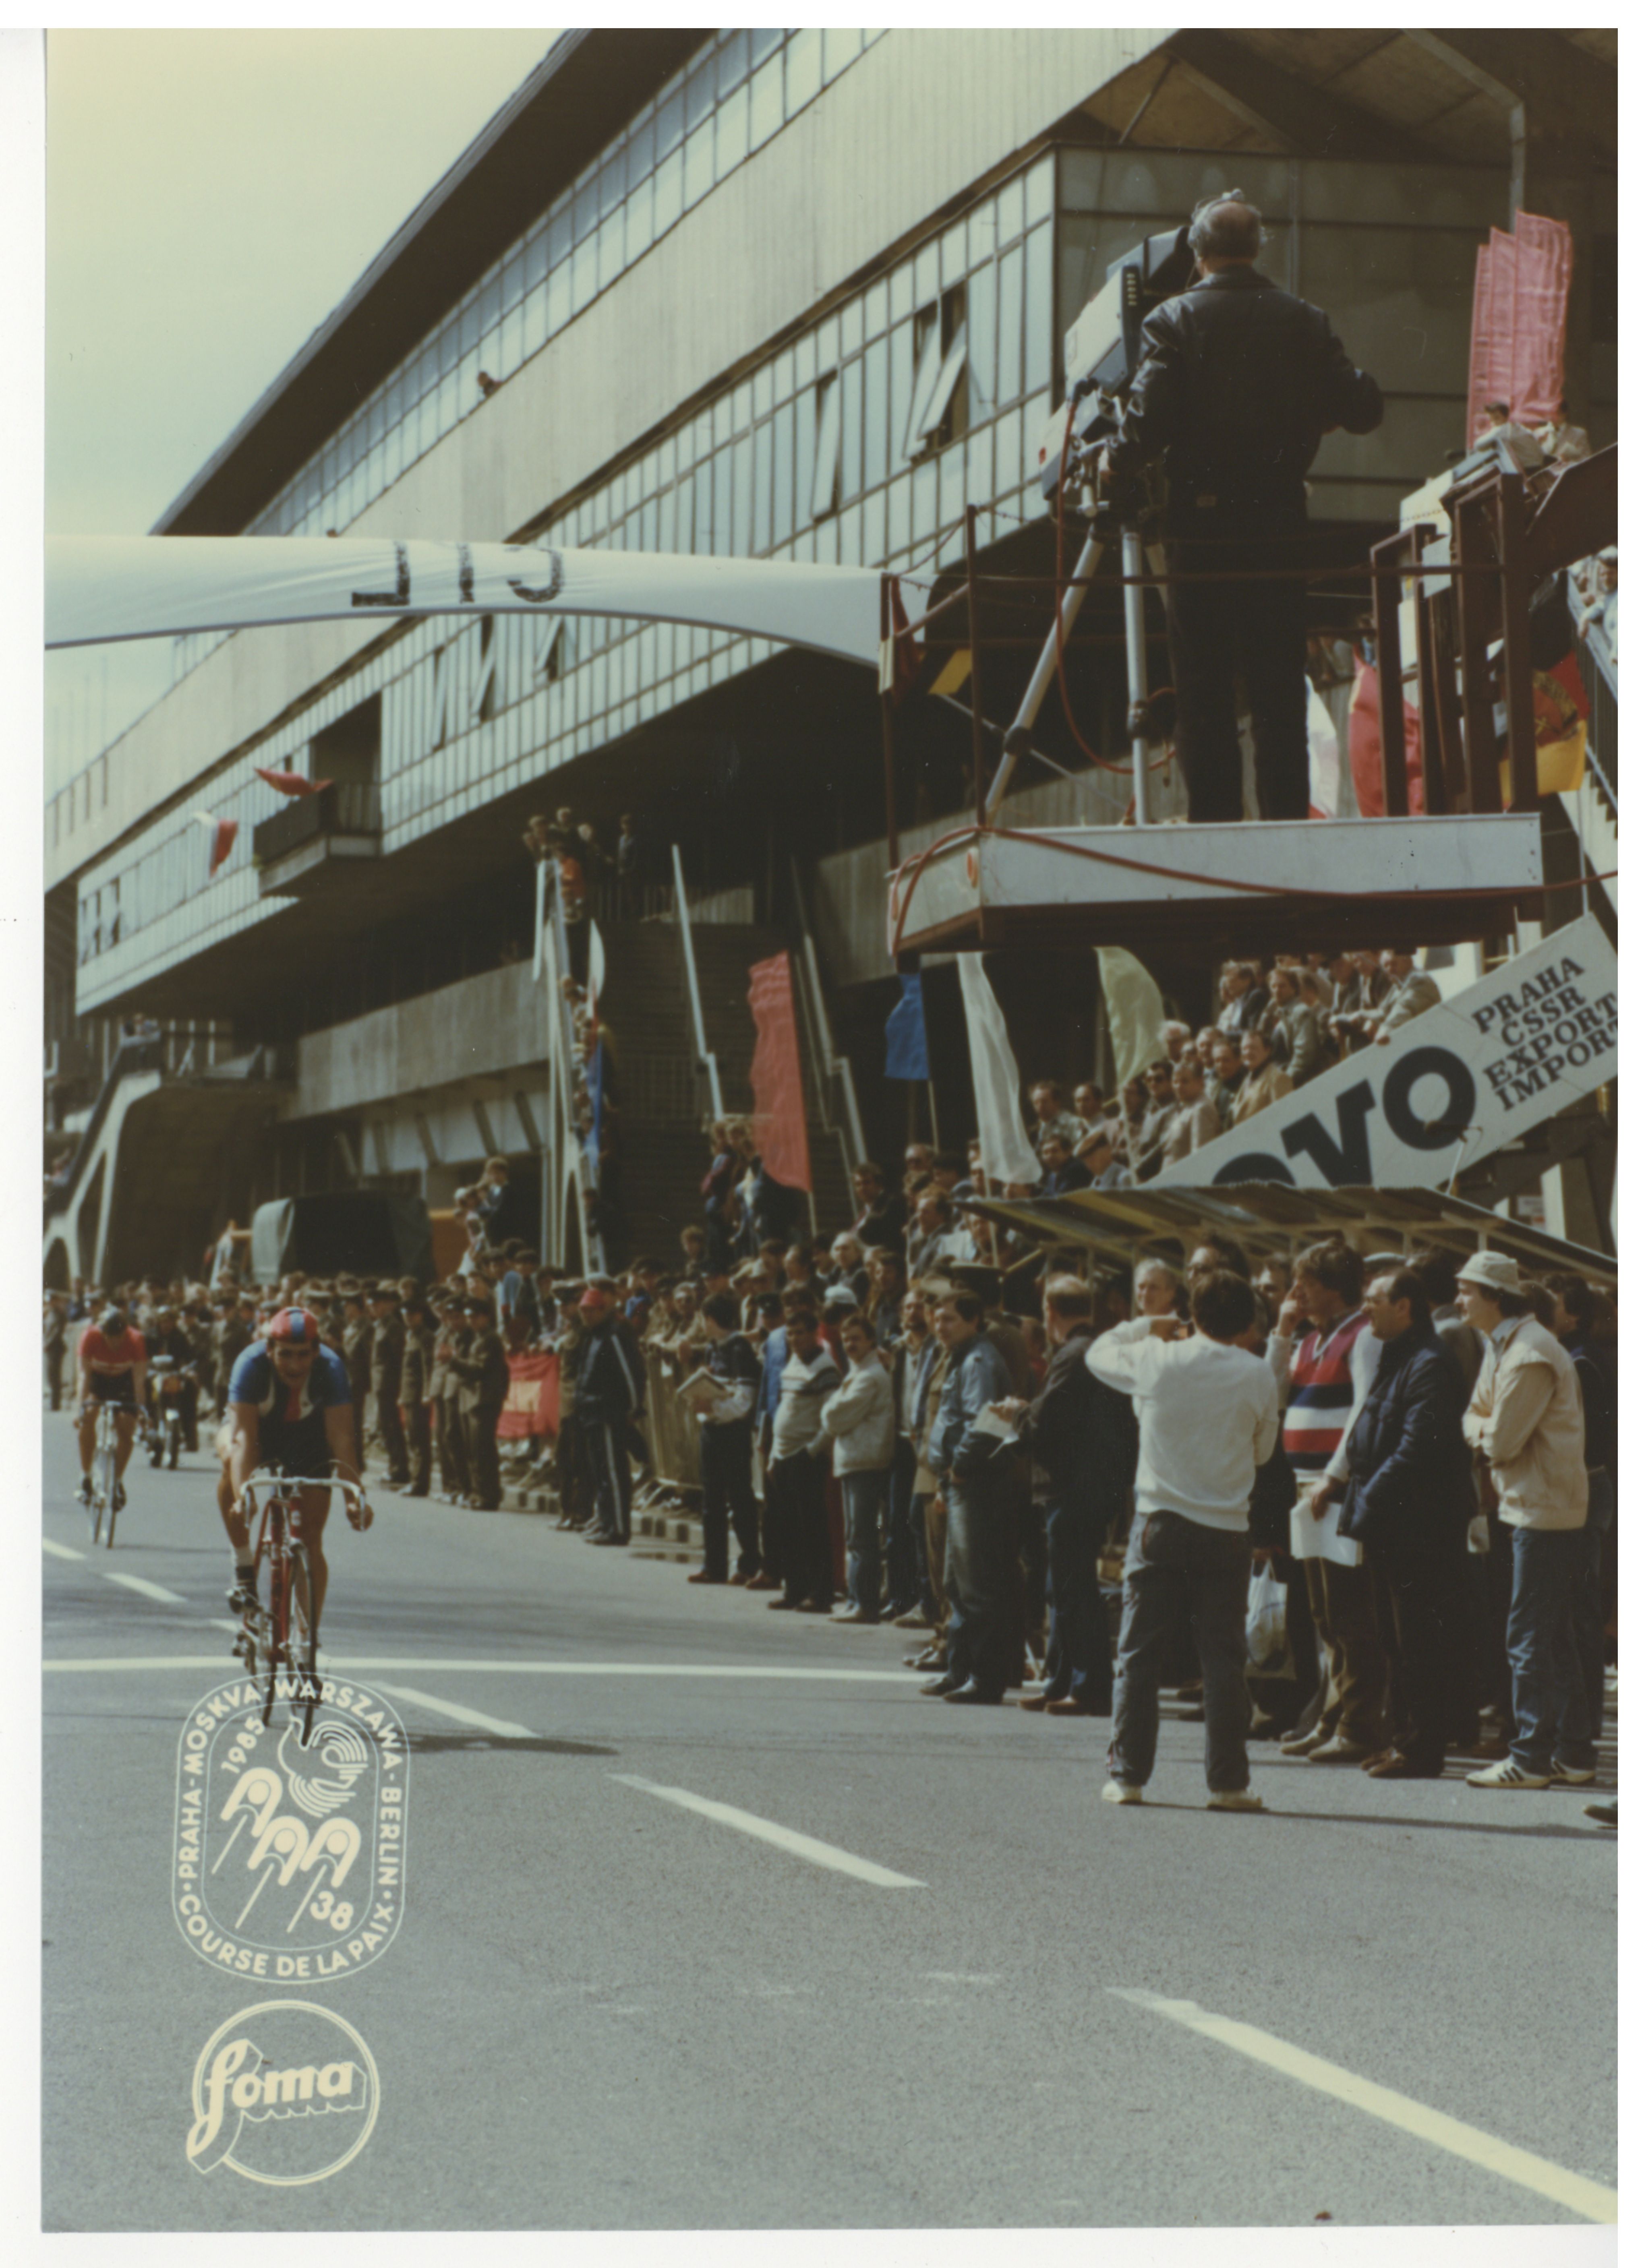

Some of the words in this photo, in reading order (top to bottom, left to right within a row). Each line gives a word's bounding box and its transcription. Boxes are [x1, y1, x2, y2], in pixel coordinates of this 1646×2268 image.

[1471, 956, 1586, 1035] PRAHA
[1501, 985, 1586, 1047] CSSR
[1482, 991, 1618, 1089] EXPORT
